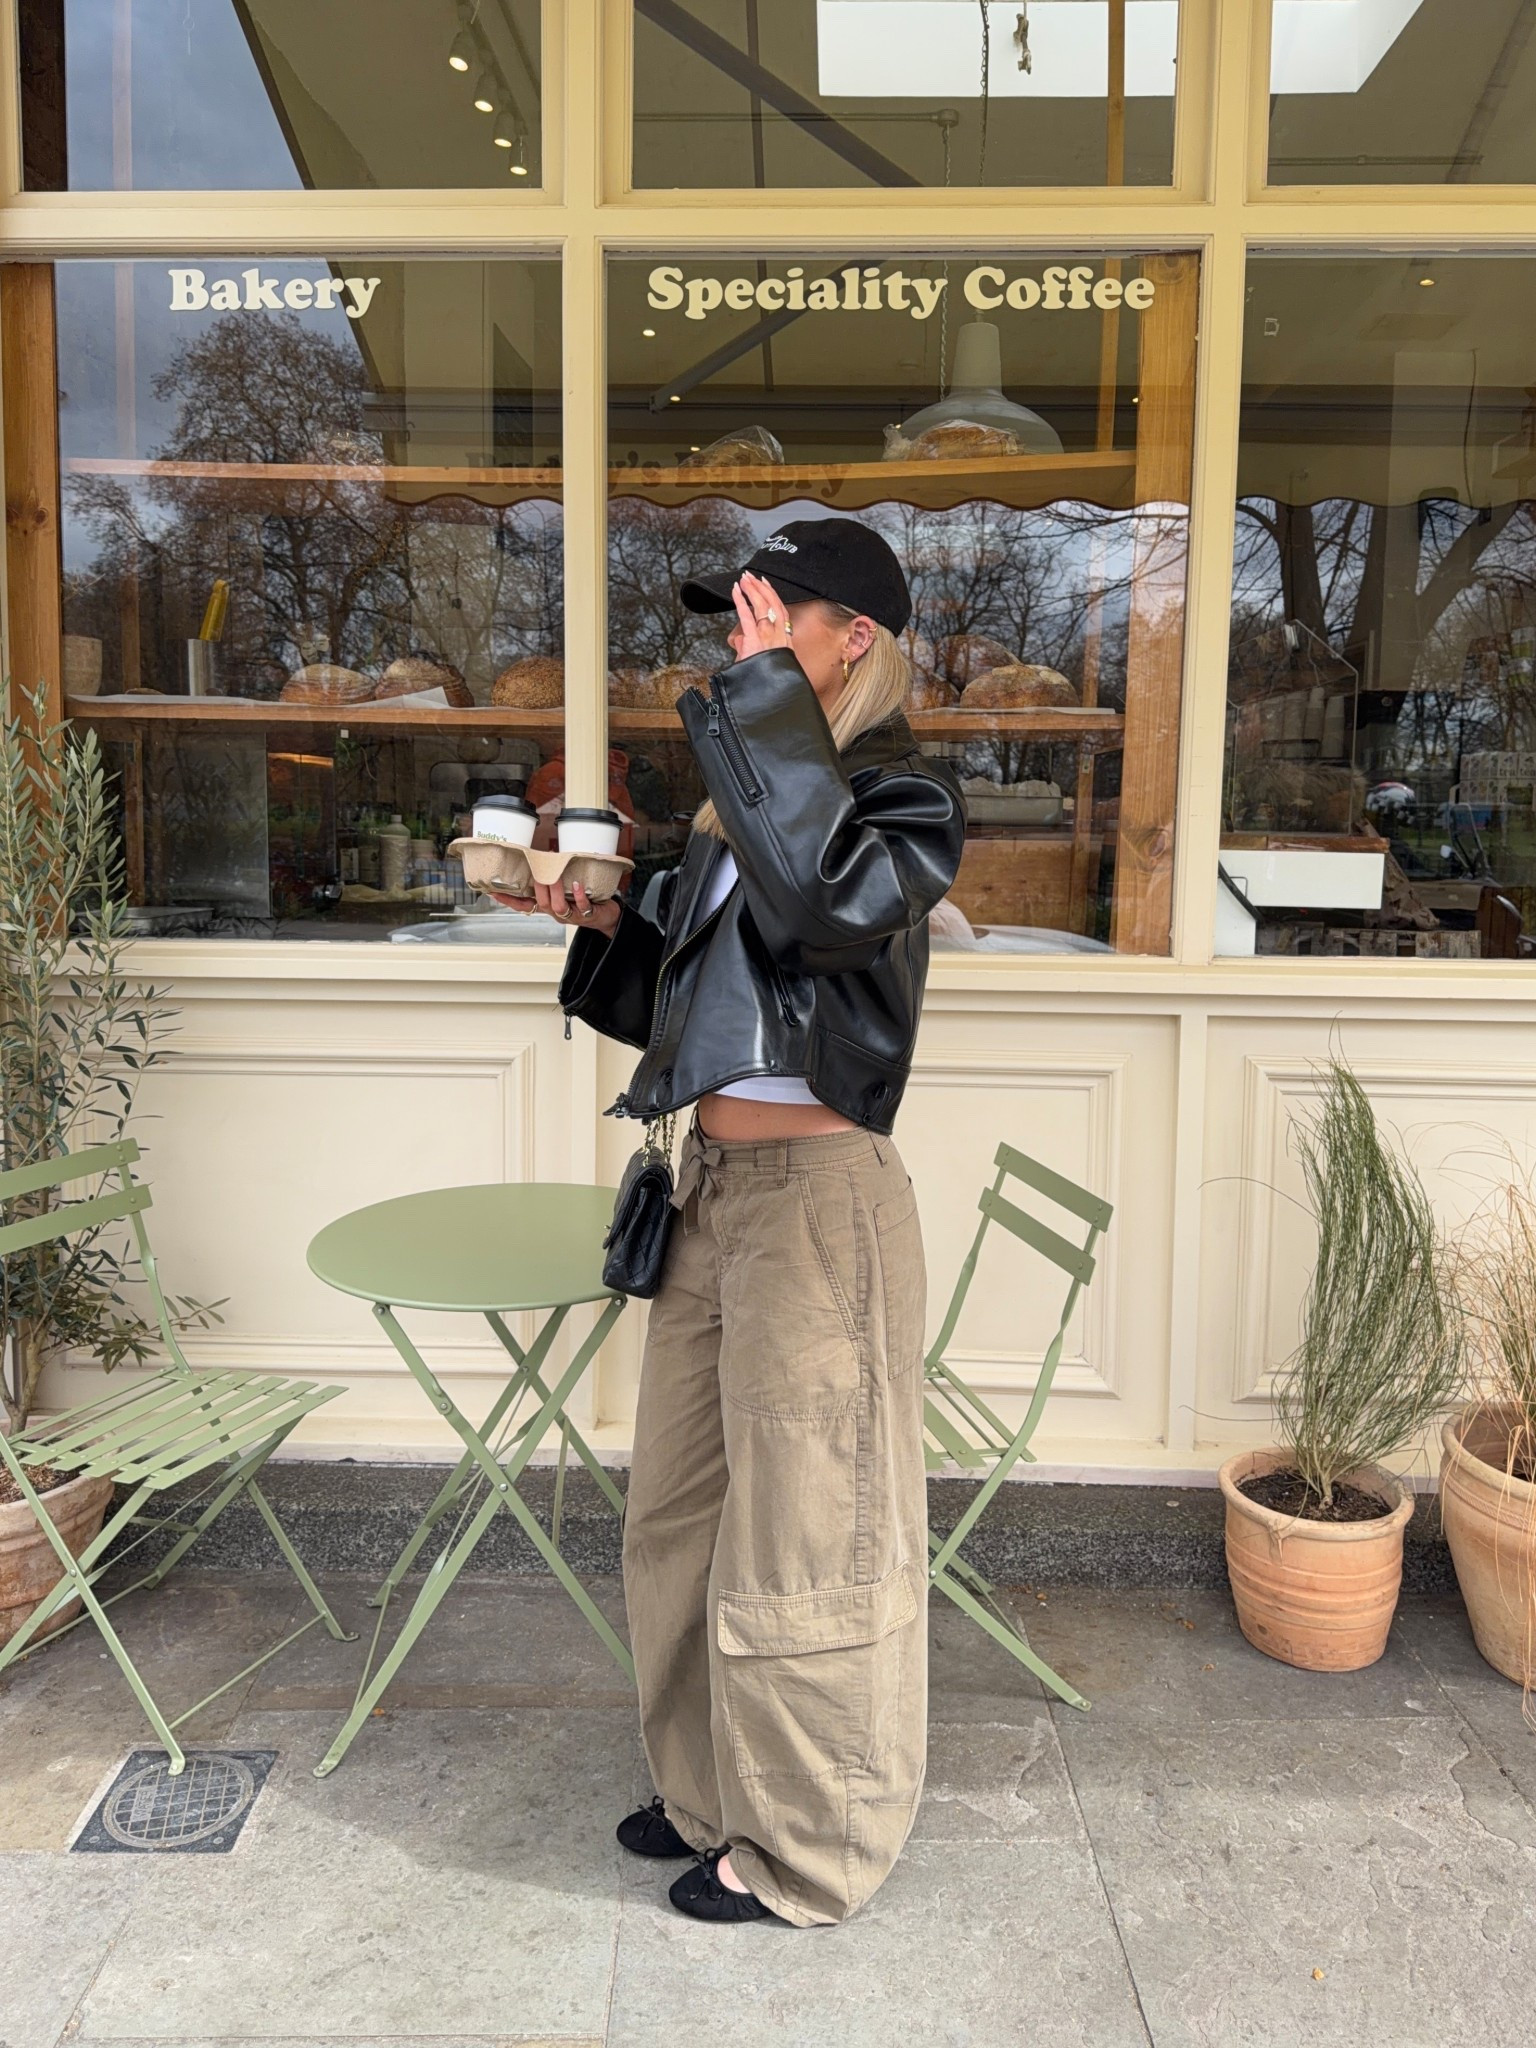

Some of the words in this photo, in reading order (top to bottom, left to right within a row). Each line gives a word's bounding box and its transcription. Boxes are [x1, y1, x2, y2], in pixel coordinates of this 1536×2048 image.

[168, 268, 382, 319] Bakery
[647, 266, 948, 320] Speciality
[963, 266, 1156, 310] Coffee
[466, 451, 661, 493] Budy's
